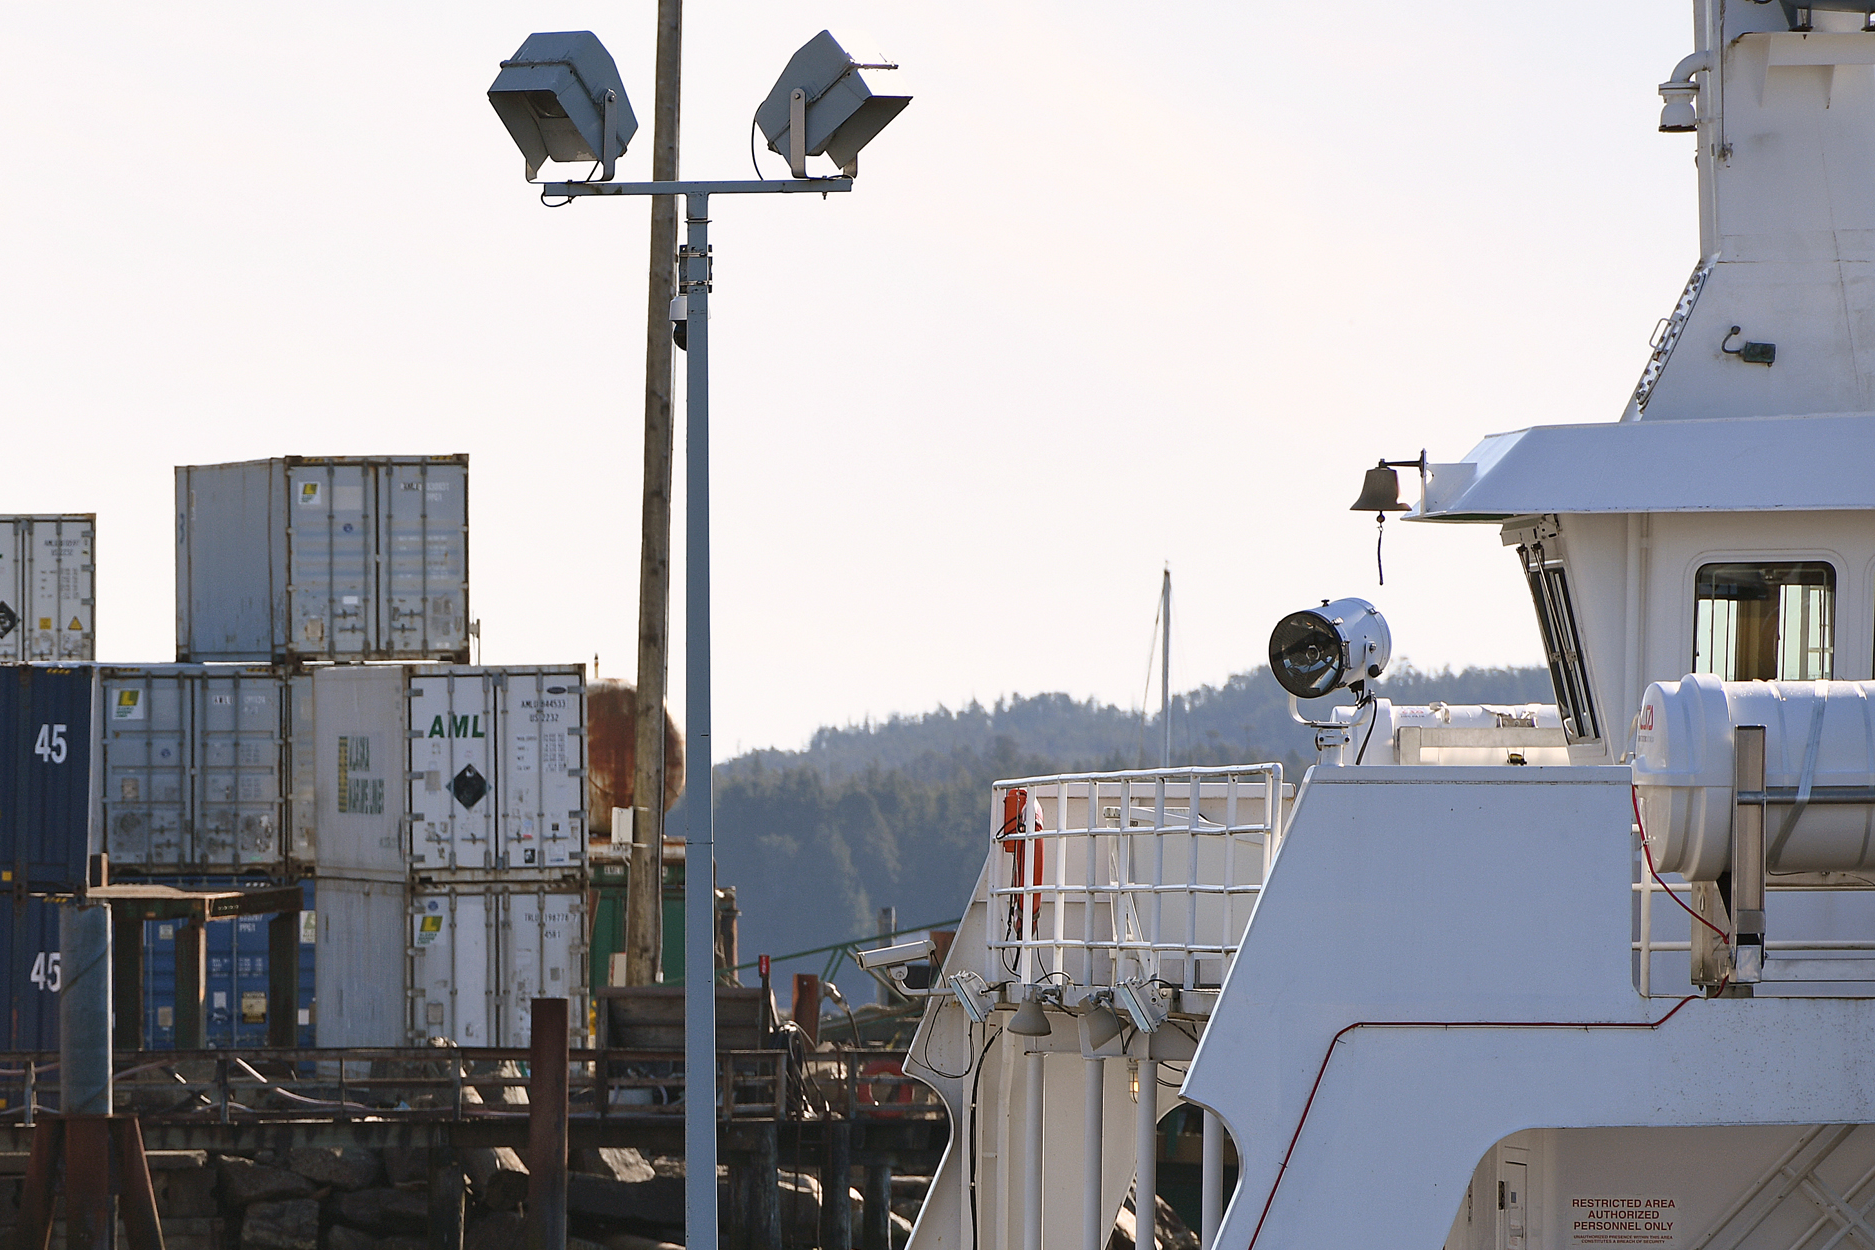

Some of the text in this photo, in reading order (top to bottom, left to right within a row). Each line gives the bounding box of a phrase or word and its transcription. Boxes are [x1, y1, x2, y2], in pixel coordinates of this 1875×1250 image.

[428, 714, 485, 738] AML
[34, 724, 67, 764] 45
[30, 952, 61, 992] 45
[1572, 1199, 1676, 1208] RESTRICTED AREA
[1588, 1210, 1660, 1219] AUTHORIZED
[1573, 1222, 1674, 1231] PERSONNEL ONLY
